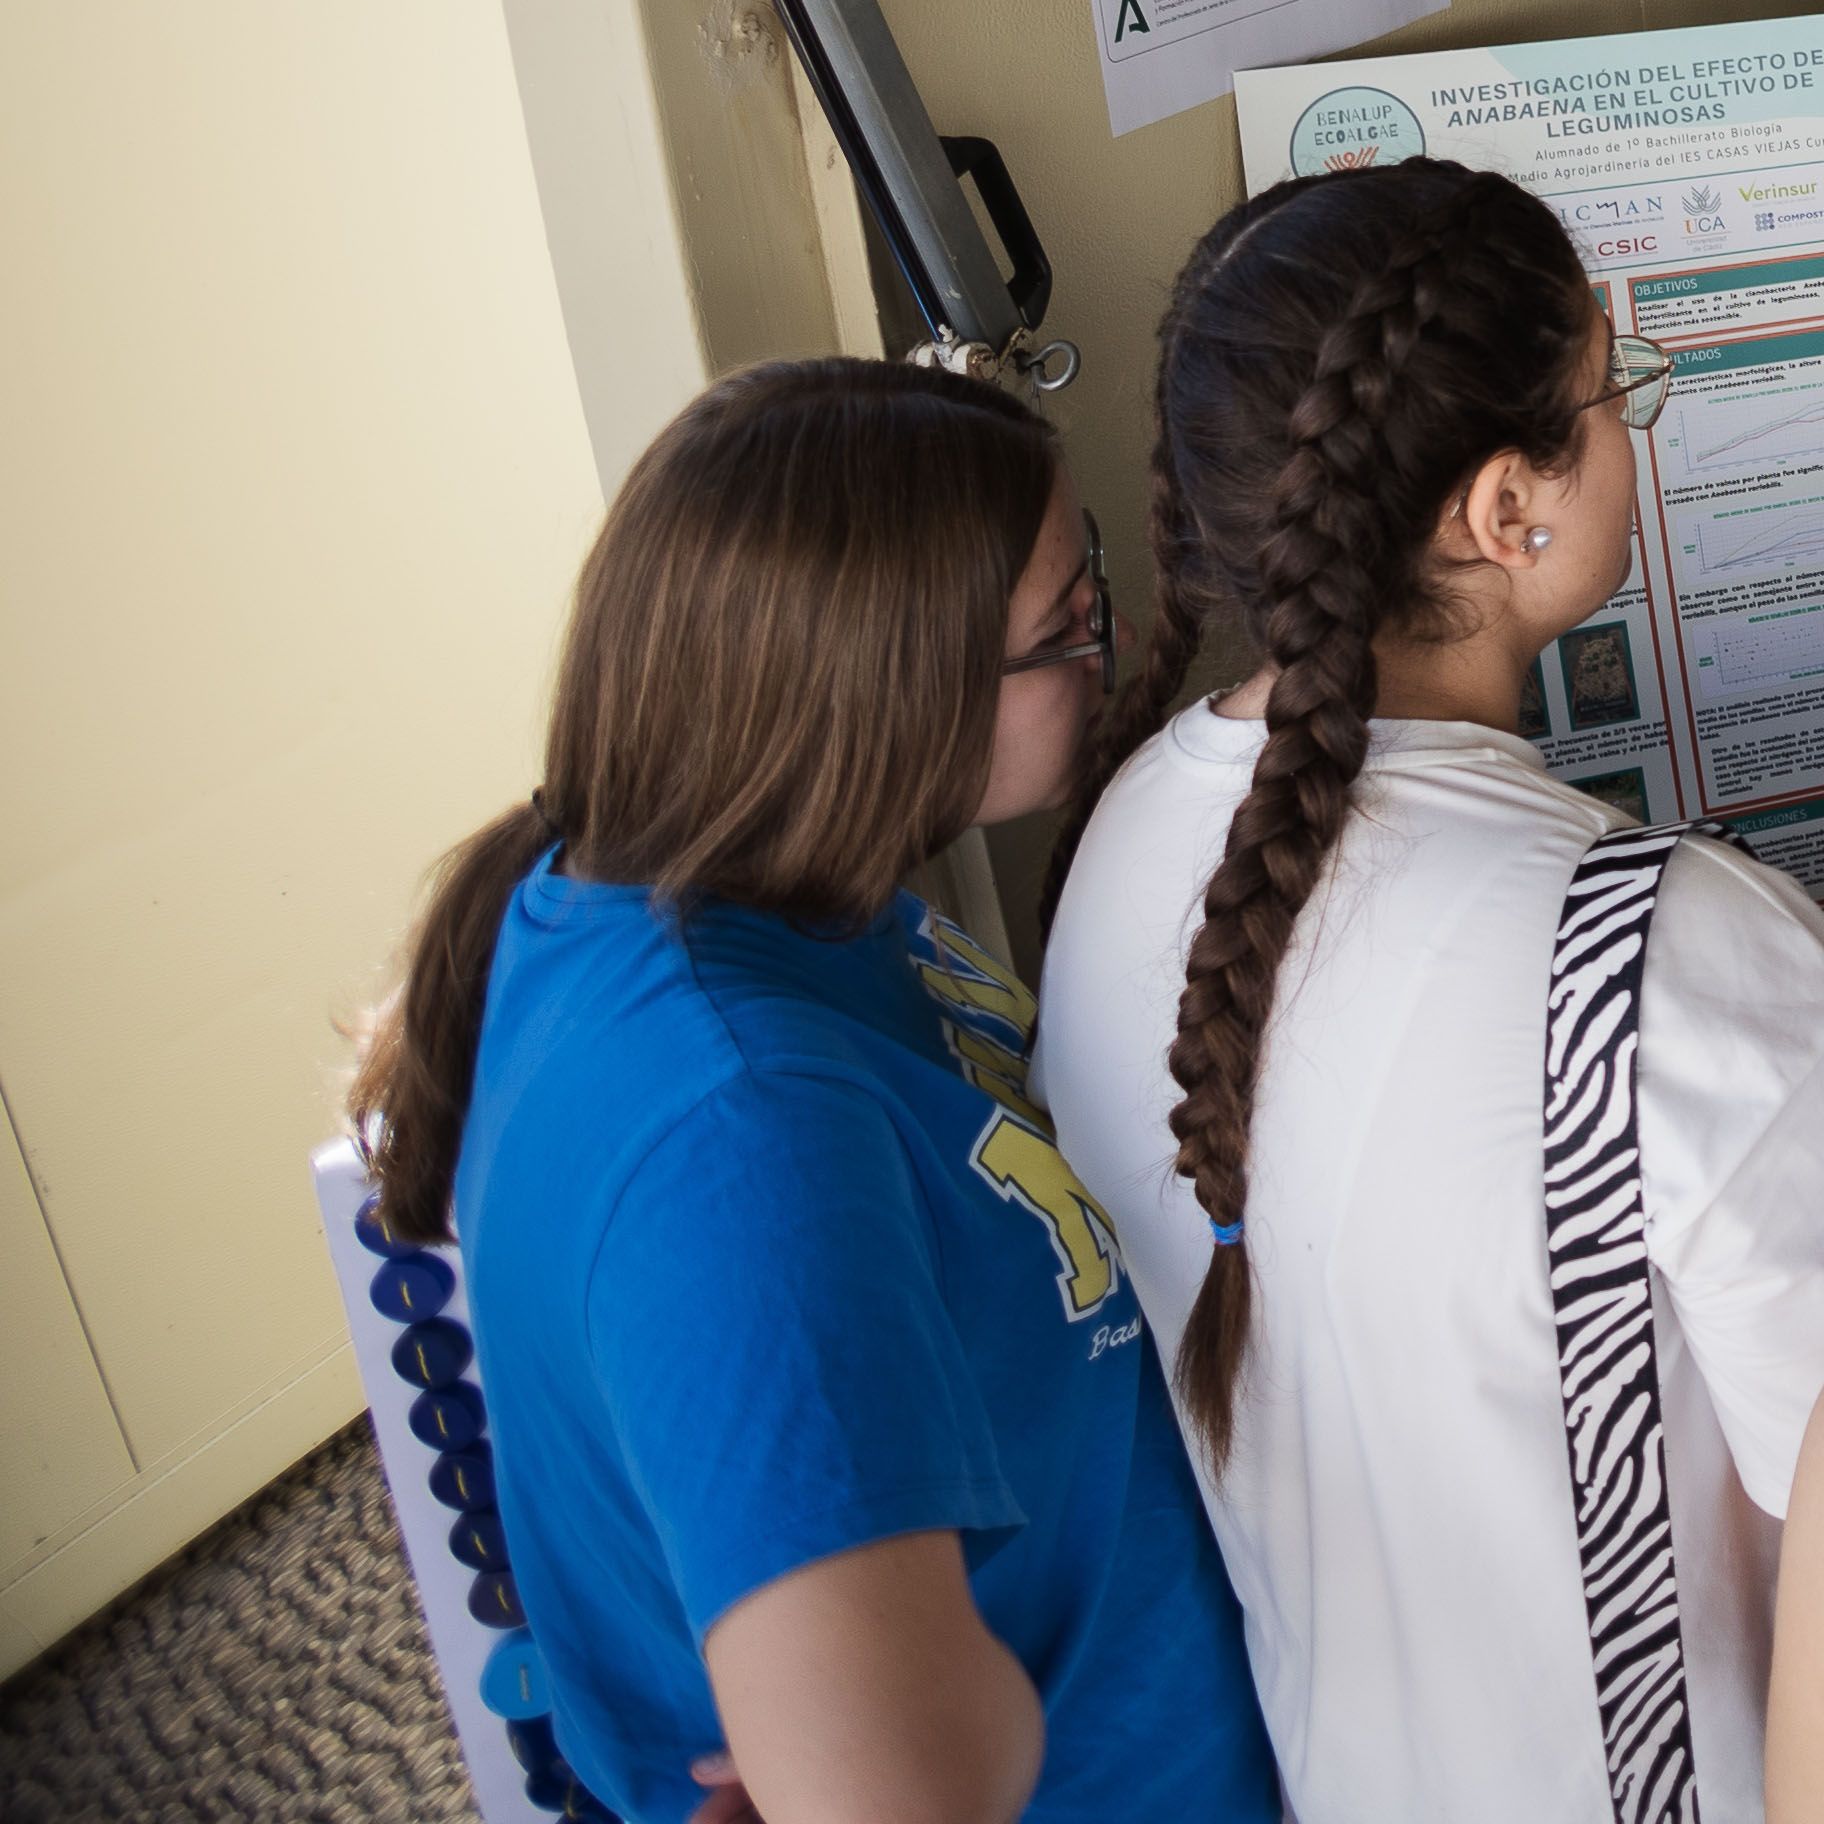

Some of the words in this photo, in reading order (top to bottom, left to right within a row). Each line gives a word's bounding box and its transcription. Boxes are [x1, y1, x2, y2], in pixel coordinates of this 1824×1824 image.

[1431, 69, 1630, 106] INVESTIGACIÓN
[1638, 64, 1685, 83] DEL
[1692, 53, 1785, 77] EFECTO
[1793, 49, 1823, 66] DE
[1447, 96, 1585, 127] ANABAENA
[1593, 92, 1625, 110] EN
[1634, 89, 1662, 106] EL
[1669, 76, 1774, 101] CULTIVO
[1783, 71, 1813, 89] DE
[1317, 105, 1392, 127] BENALUP
[1546, 103, 1724, 137] LEGUMINOSAS
[1314, 123, 1399, 146] ECOALGAE
[1535, 144, 1599, 160] Alumnado
[1605, 142, 1620, 152] de
[1646, 131, 1724, 148] Bachillerato
[1730, 123, 1782, 137] Biología
[1554, 159, 1649, 179] Agrojardinería
[1655, 154, 1674, 166] del
[1680, 150, 1700, 162] IES
[1706, 144, 1748, 159] CASAS
[1754, 138, 1800, 153] VIEJAS
[1739, 180, 1817, 203] Verinsur
[1597, 236, 1658, 257] CSIC
[1634, 278, 1698, 297] OBJETIVOS
[1670, 347, 1722, 365] ULTADOS
[1737, 808, 1808, 833] NCLUSIONES
